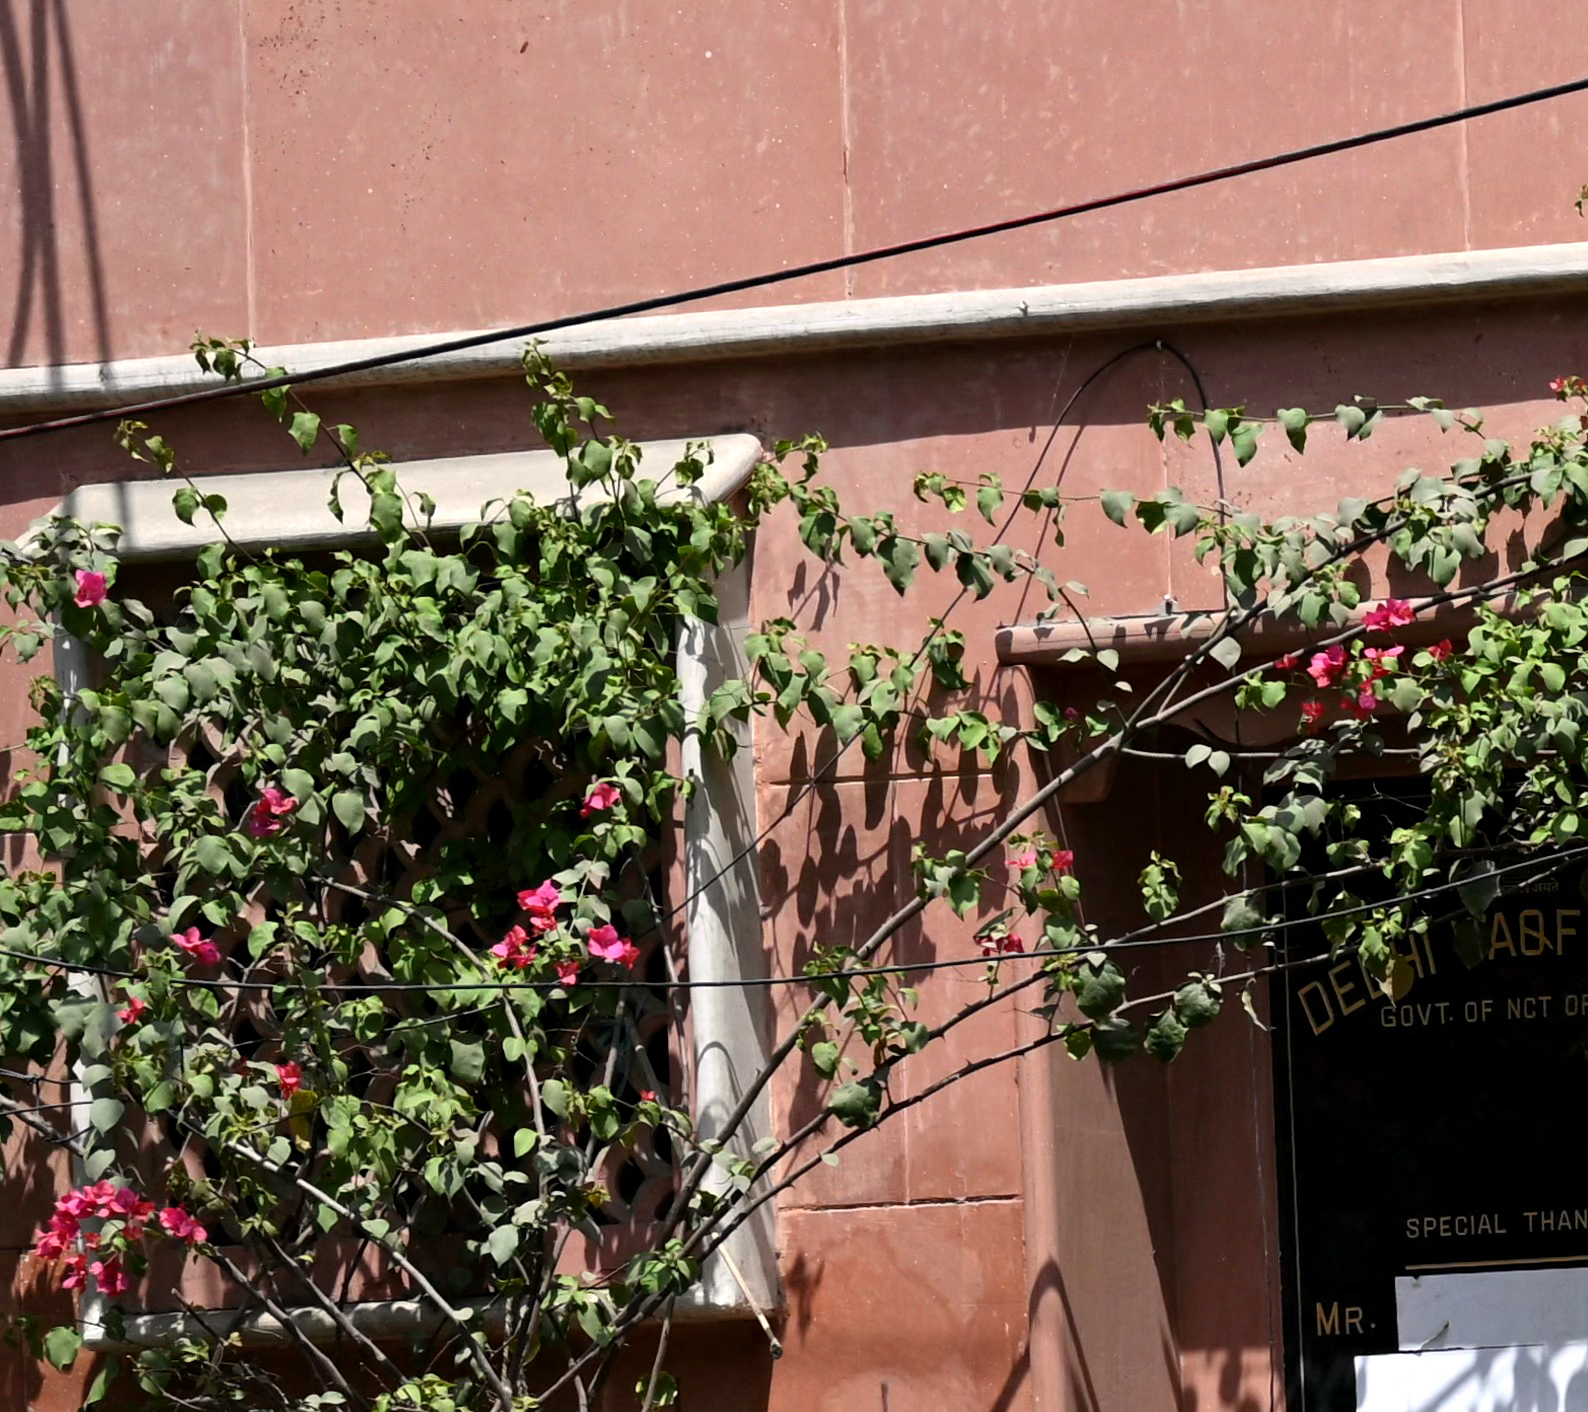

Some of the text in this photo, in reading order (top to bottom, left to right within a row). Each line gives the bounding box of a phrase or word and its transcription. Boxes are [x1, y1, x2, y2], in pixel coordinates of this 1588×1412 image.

[1474, 908, 1582, 963] AQF
[1380, 1002, 1453, 1028] GOVT.
[1464, 1000, 1493, 1023] OF
[1506, 997, 1551, 1020] NCT
[1405, 1213, 1506, 1239] SPECIAL
